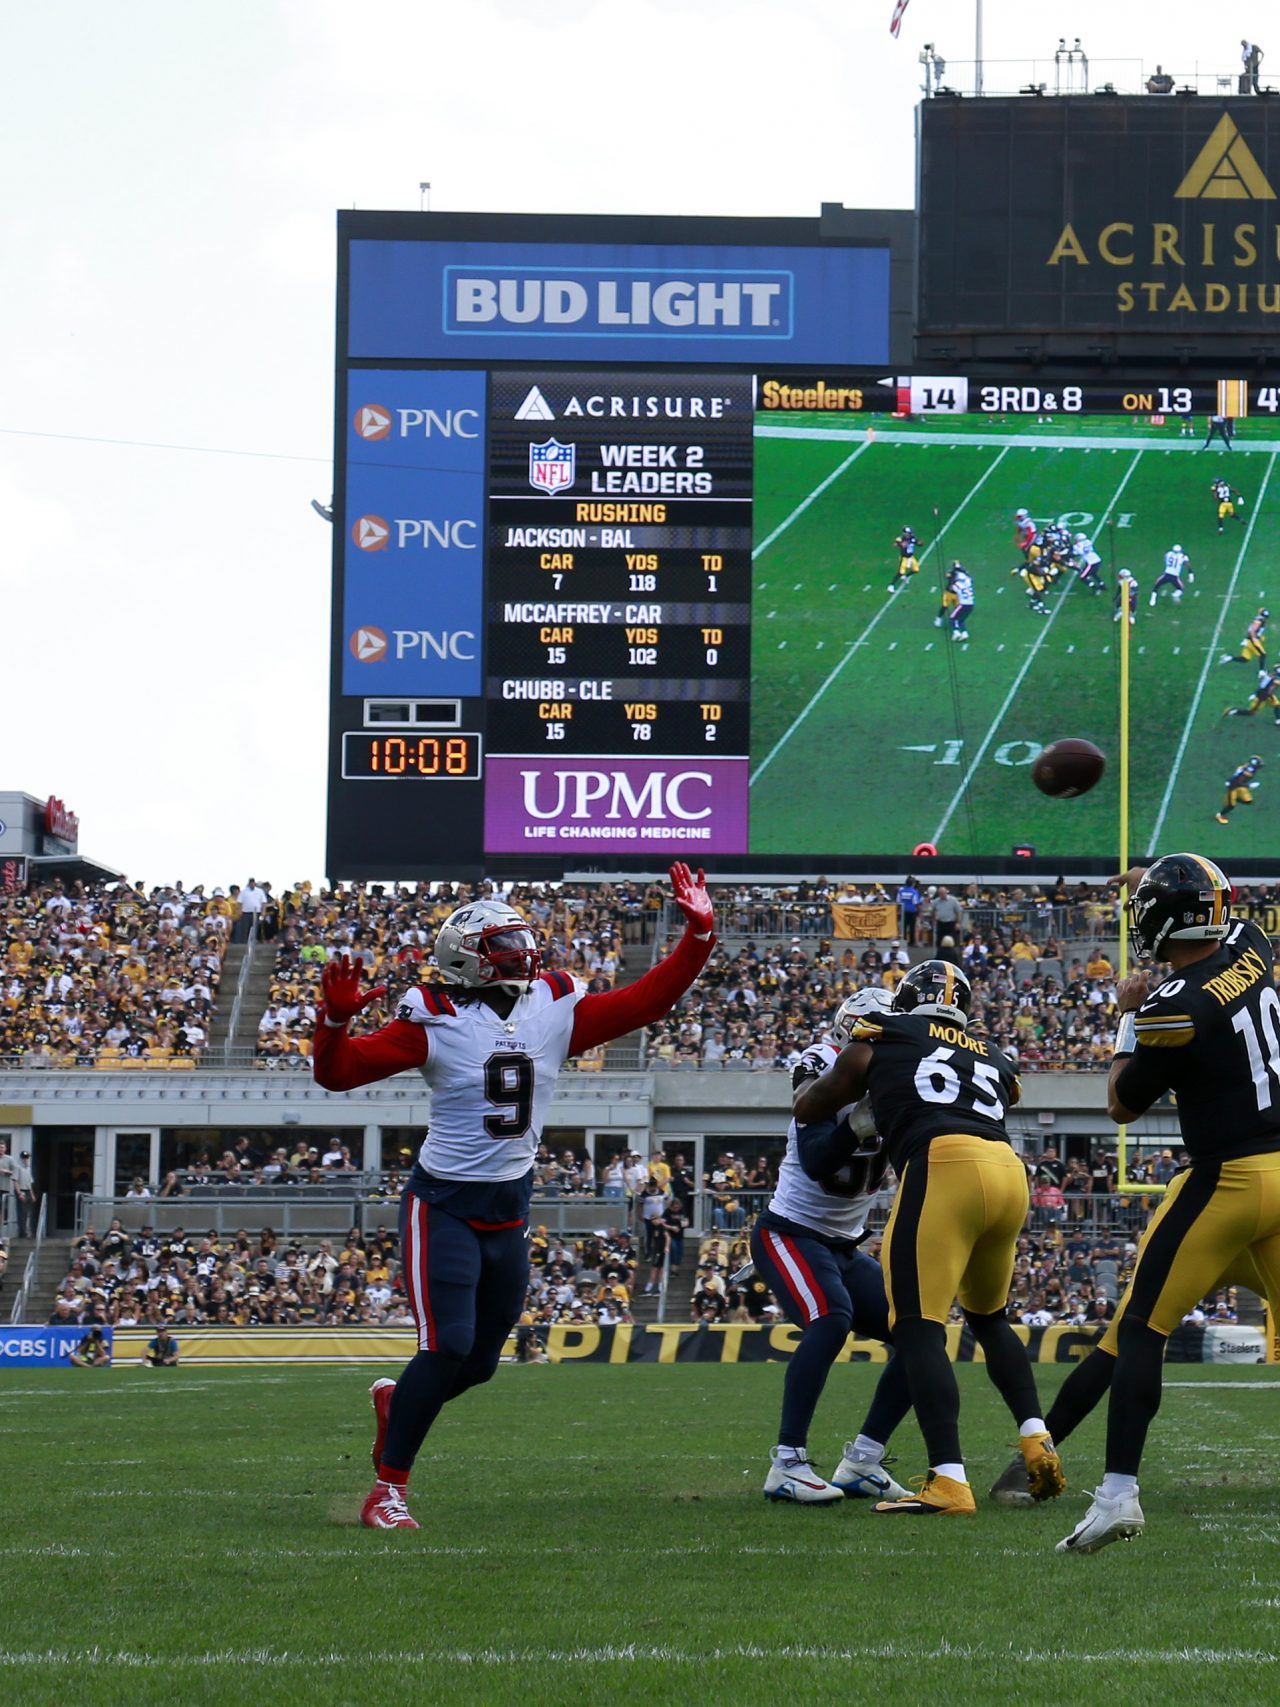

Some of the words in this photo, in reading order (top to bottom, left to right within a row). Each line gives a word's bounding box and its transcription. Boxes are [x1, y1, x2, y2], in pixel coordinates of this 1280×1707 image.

[456, 279, 588, 323] BUD
[762, 380, 863, 411] Steelers
[922, 388, 955, 410] 14
[980, 386, 1040, 412] 3RD
[1044, 392, 1058, 410] &
[1063, 387, 1083, 412] 8
[1122, 394, 1153, 411] ON
[1158, 388, 1192, 413] 13
[396, 409, 480, 438] PNC
[600, 445, 677, 468] WEEK
[684, 446, 704, 468] 2
[535, 463, 568, 485] NFL
[591, 472, 712, 495] LEADERS
[576, 503, 666, 523] RUSHING
[394, 520, 477, 549] PNC
[505, 528, 586, 548] JACKSON
[601, 529, 634, 549] BAL
[540, 555, 573, 572] CAR
[625, 555, 658, 572] YDS
[701, 555, 722, 572] TD
[553, 575, 563, 590] 7
[629, 575, 656, 592] 118
[707, 576, 717, 592] 1
[504, 604, 612, 624] MCCAFFREY
[626, 605, 662, 623] CAR
[393, 631, 476, 660] PNC
[540, 628, 573, 645] CAR
[625, 628, 658, 645] YDS
[701, 628, 722, 645] TD
[547, 648, 566, 664] 15
[628, 649, 657, 665] 102
[707, 649, 718, 665] 0
[502, 680, 565, 699] CHUBB
[579, 680, 612, 700] CLE
[539, 704, 572, 721] CAR
[624, 704, 657, 721] YDS
[701, 704, 721, 721] TD
[546, 724, 564, 740] 15
[632, 724, 652, 741] 78
[705, 725, 716, 741] 2
[371, 738, 467, 774] 10:08
[520, 771, 712, 820] UPMC
[525, 827, 556, 838] LIFE
[560, 827, 638, 839] CHANGING
[641, 827, 711, 839] MEDICINE
[1202, 947, 1267, 1006] TRUBISKY
[929, 1023, 989, 1057] MOORE
[914, 1047, 1005, 1121] 65
[484, 1052, 535, 1139] 9
[4, 1340, 47, 1357] CBS
[1220, 1341, 1260, 1353] Steelers
